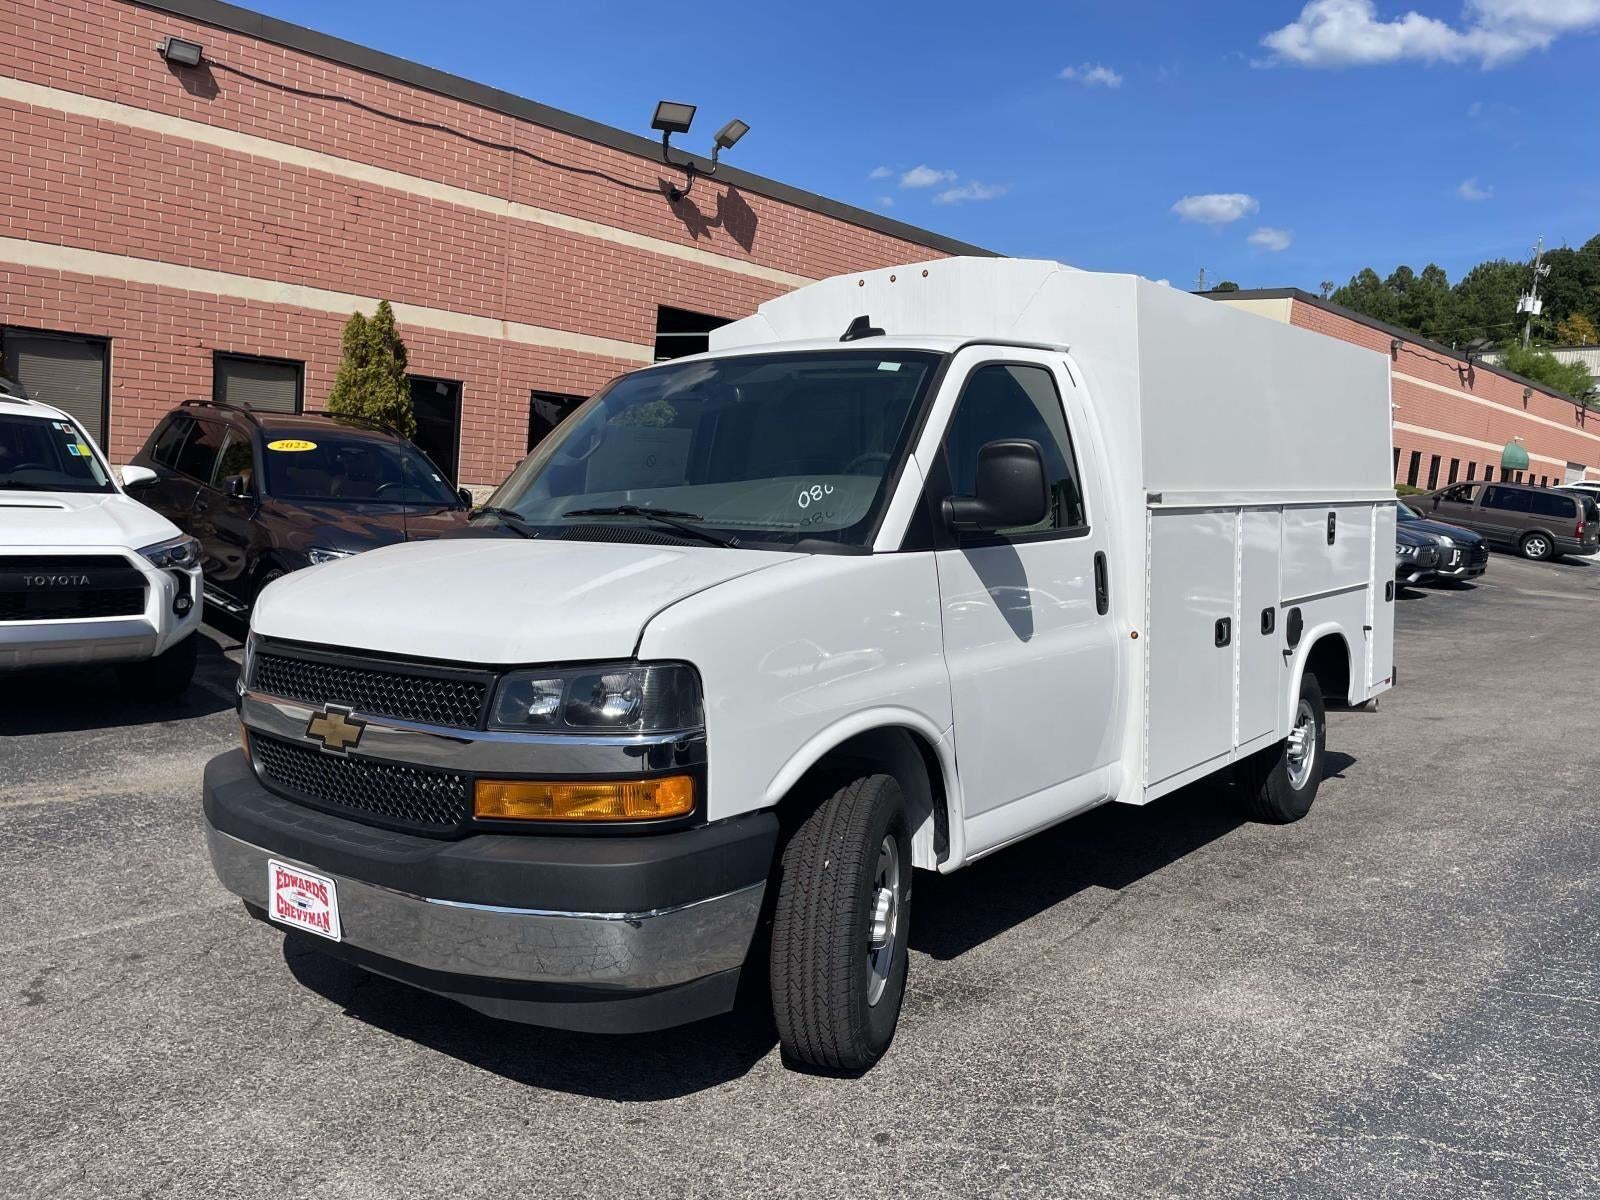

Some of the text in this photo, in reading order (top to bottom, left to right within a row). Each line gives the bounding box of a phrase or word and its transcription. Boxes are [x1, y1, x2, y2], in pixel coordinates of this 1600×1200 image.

[23, 575, 90, 586] TOYOTA
[276, 869, 329, 907] EDWARDS
[276, 892, 331, 931] CHEVYMAN
